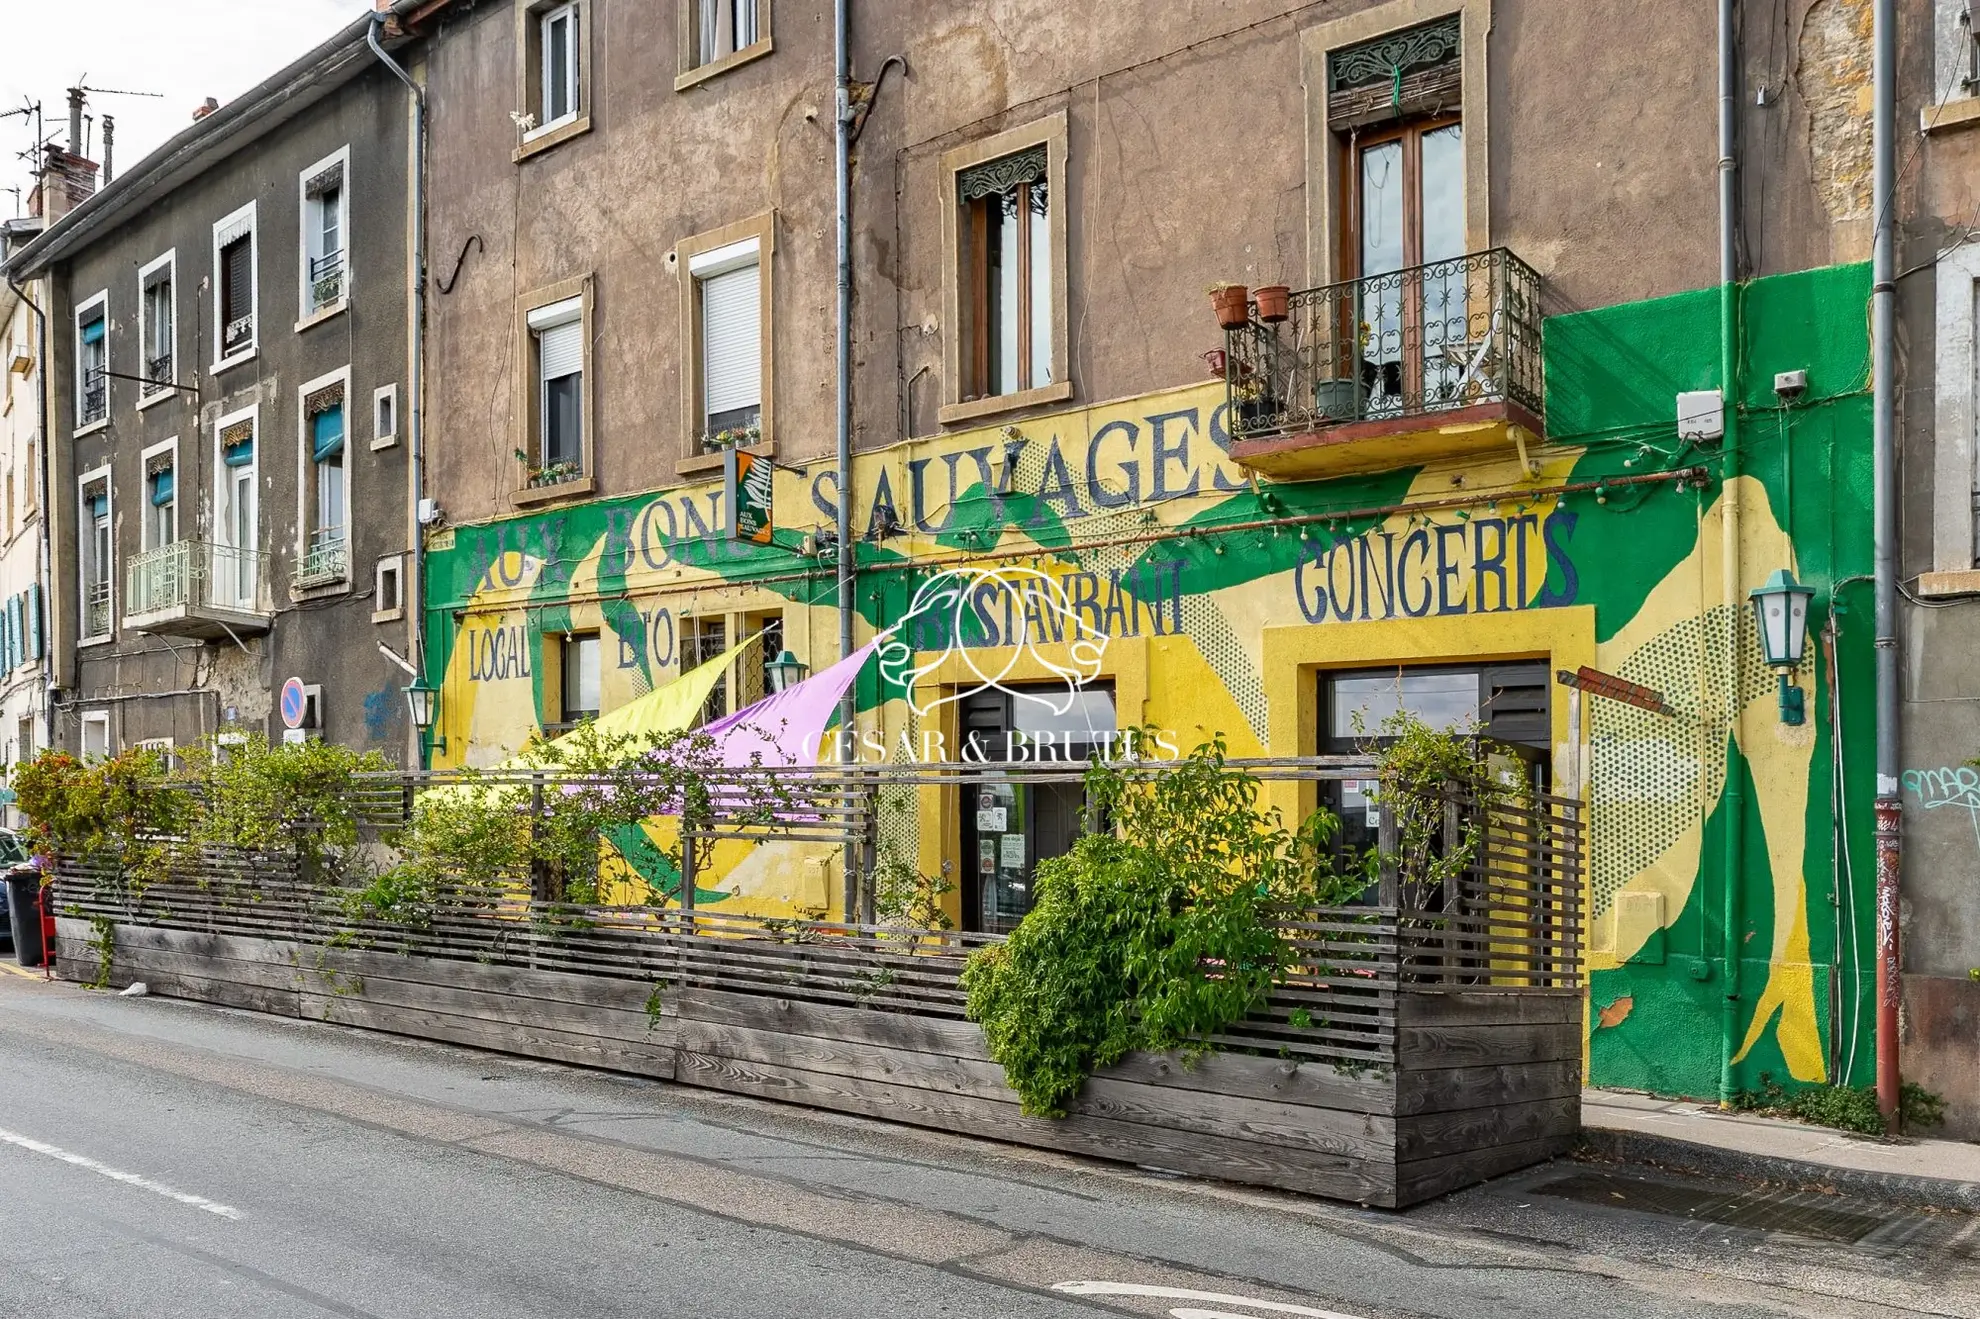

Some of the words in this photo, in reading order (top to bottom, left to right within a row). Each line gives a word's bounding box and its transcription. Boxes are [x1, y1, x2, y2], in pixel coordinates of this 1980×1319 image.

[740, 511, 752, 520] AUX
[465, 516, 567, 597] AUX
[1295, 511, 1579, 624] CONCERTS
[468, 625, 531, 682] LOCAL
